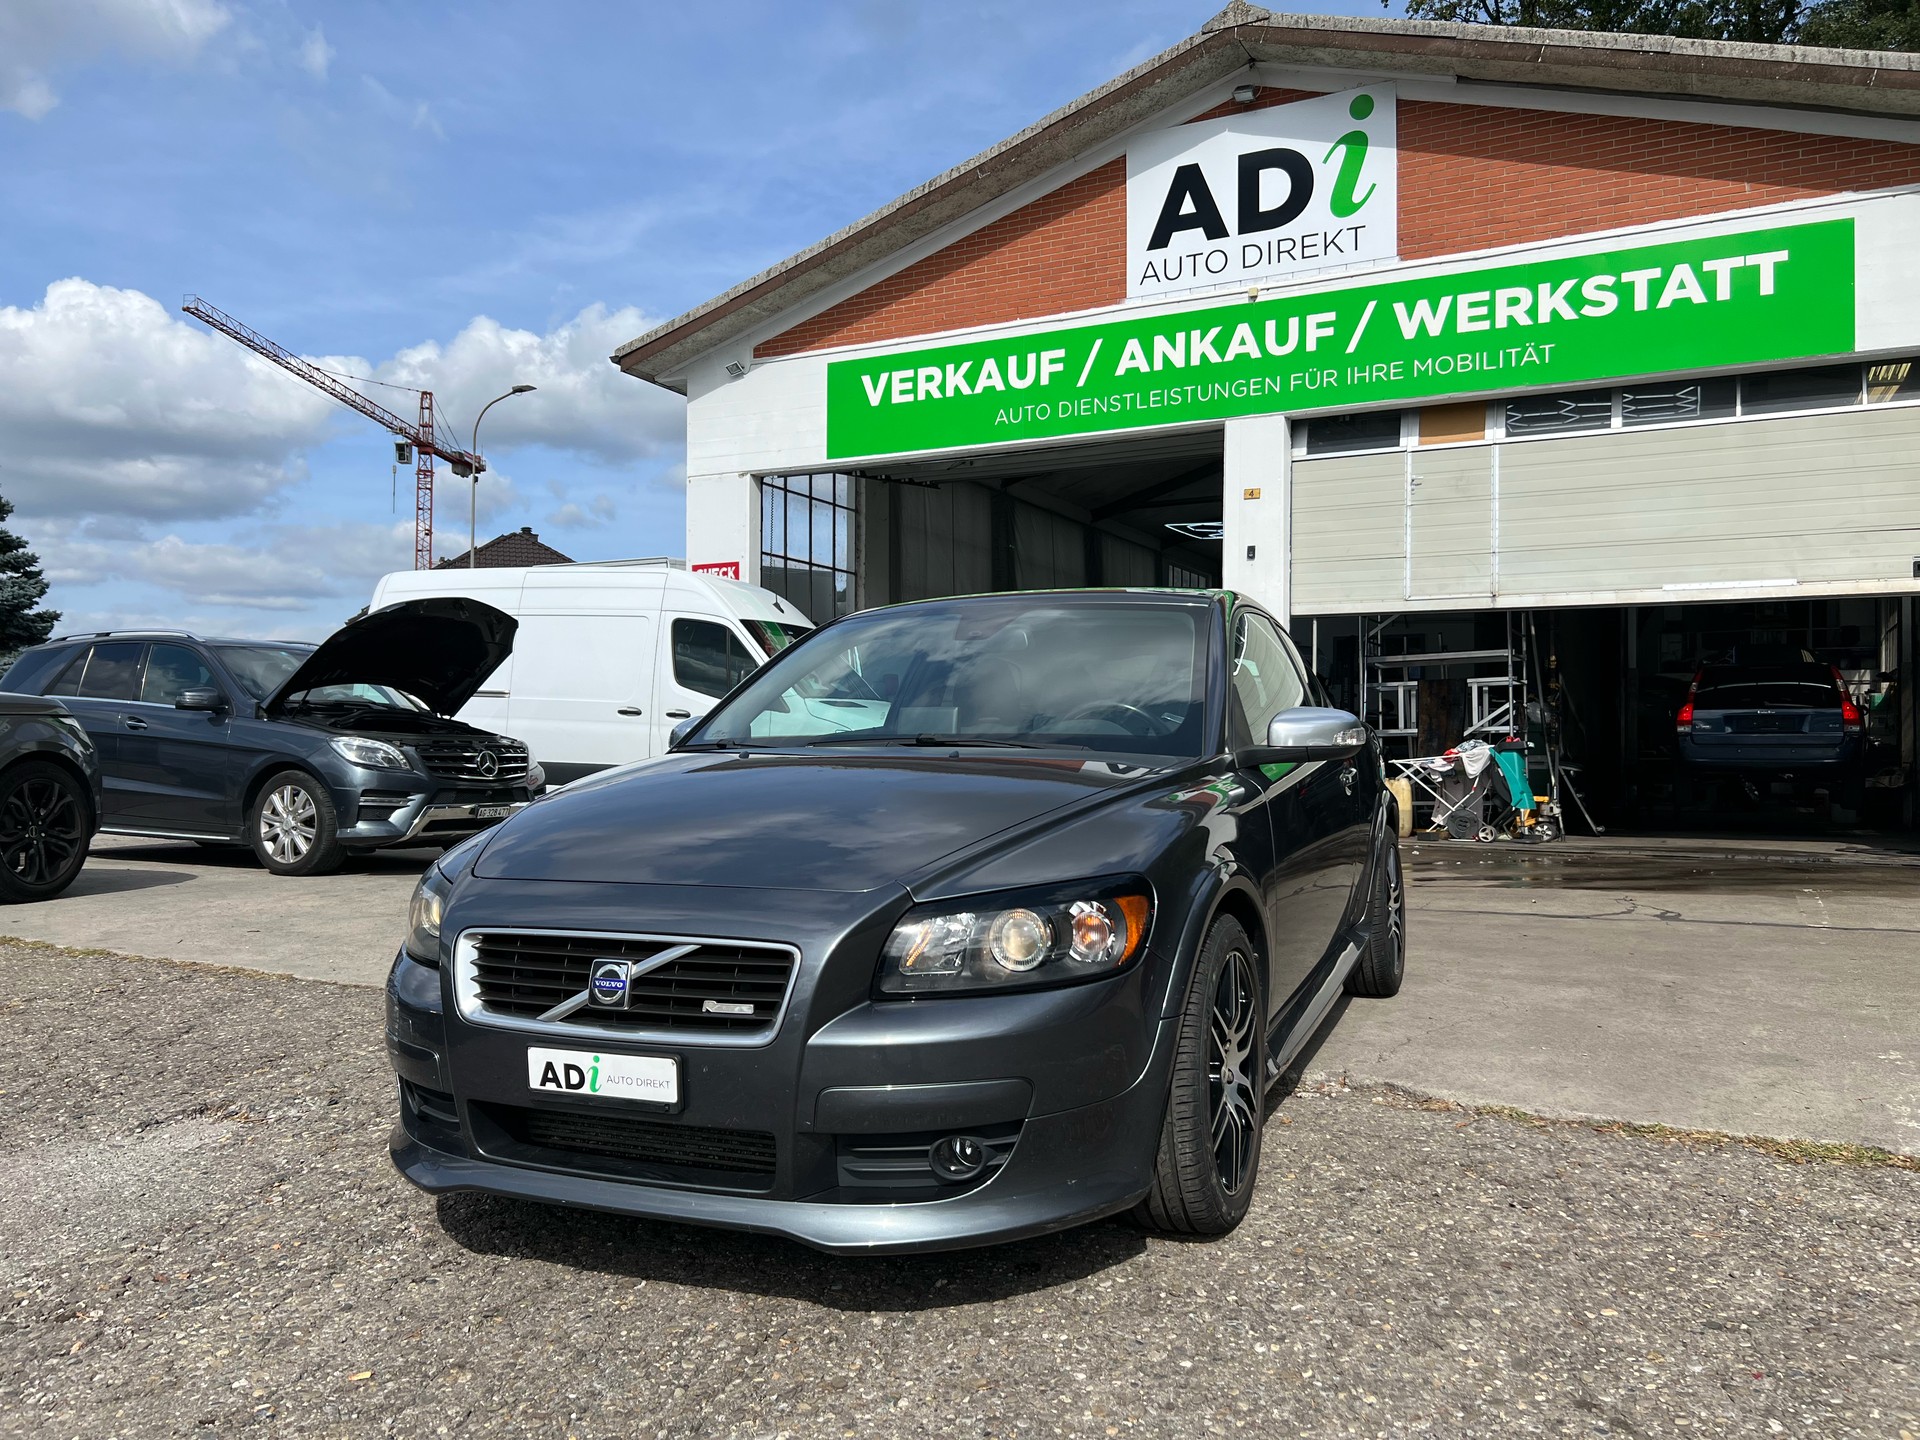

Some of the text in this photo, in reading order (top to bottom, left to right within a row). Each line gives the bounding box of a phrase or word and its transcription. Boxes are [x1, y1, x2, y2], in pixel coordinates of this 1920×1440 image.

[1146, 93, 1377, 252] ADi
[1140, 225, 1366, 286] AUTO DIREKT
[861, 348, 1066, 407] VERKAUF
[1115, 311, 1337, 377] ANKAUF
[1393, 249, 1789, 340] WERKSTATT
[995, 343, 1555, 426] AUTO DIENSTLEISTUNGEN FÜR IHRE MOBILITÄT
[595, 980, 624, 988] VOLVO
[539, 1055, 670, 1093] ADi AUTO DIREKT
